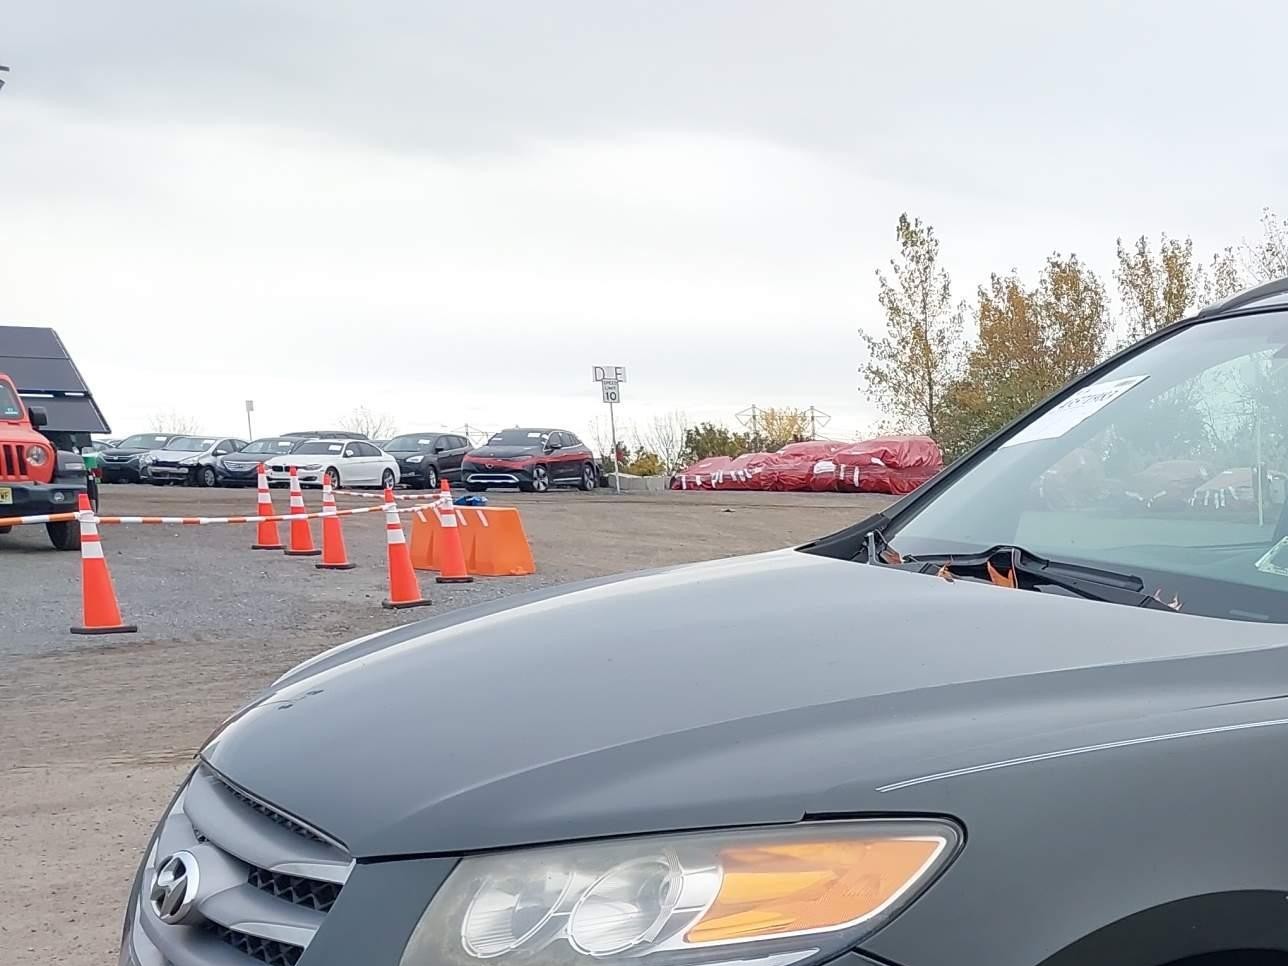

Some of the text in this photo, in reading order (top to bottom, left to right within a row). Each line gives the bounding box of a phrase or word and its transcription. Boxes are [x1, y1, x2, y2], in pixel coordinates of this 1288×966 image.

[594, 366, 623, 382] D E
[606, 392, 617, 401] 10
